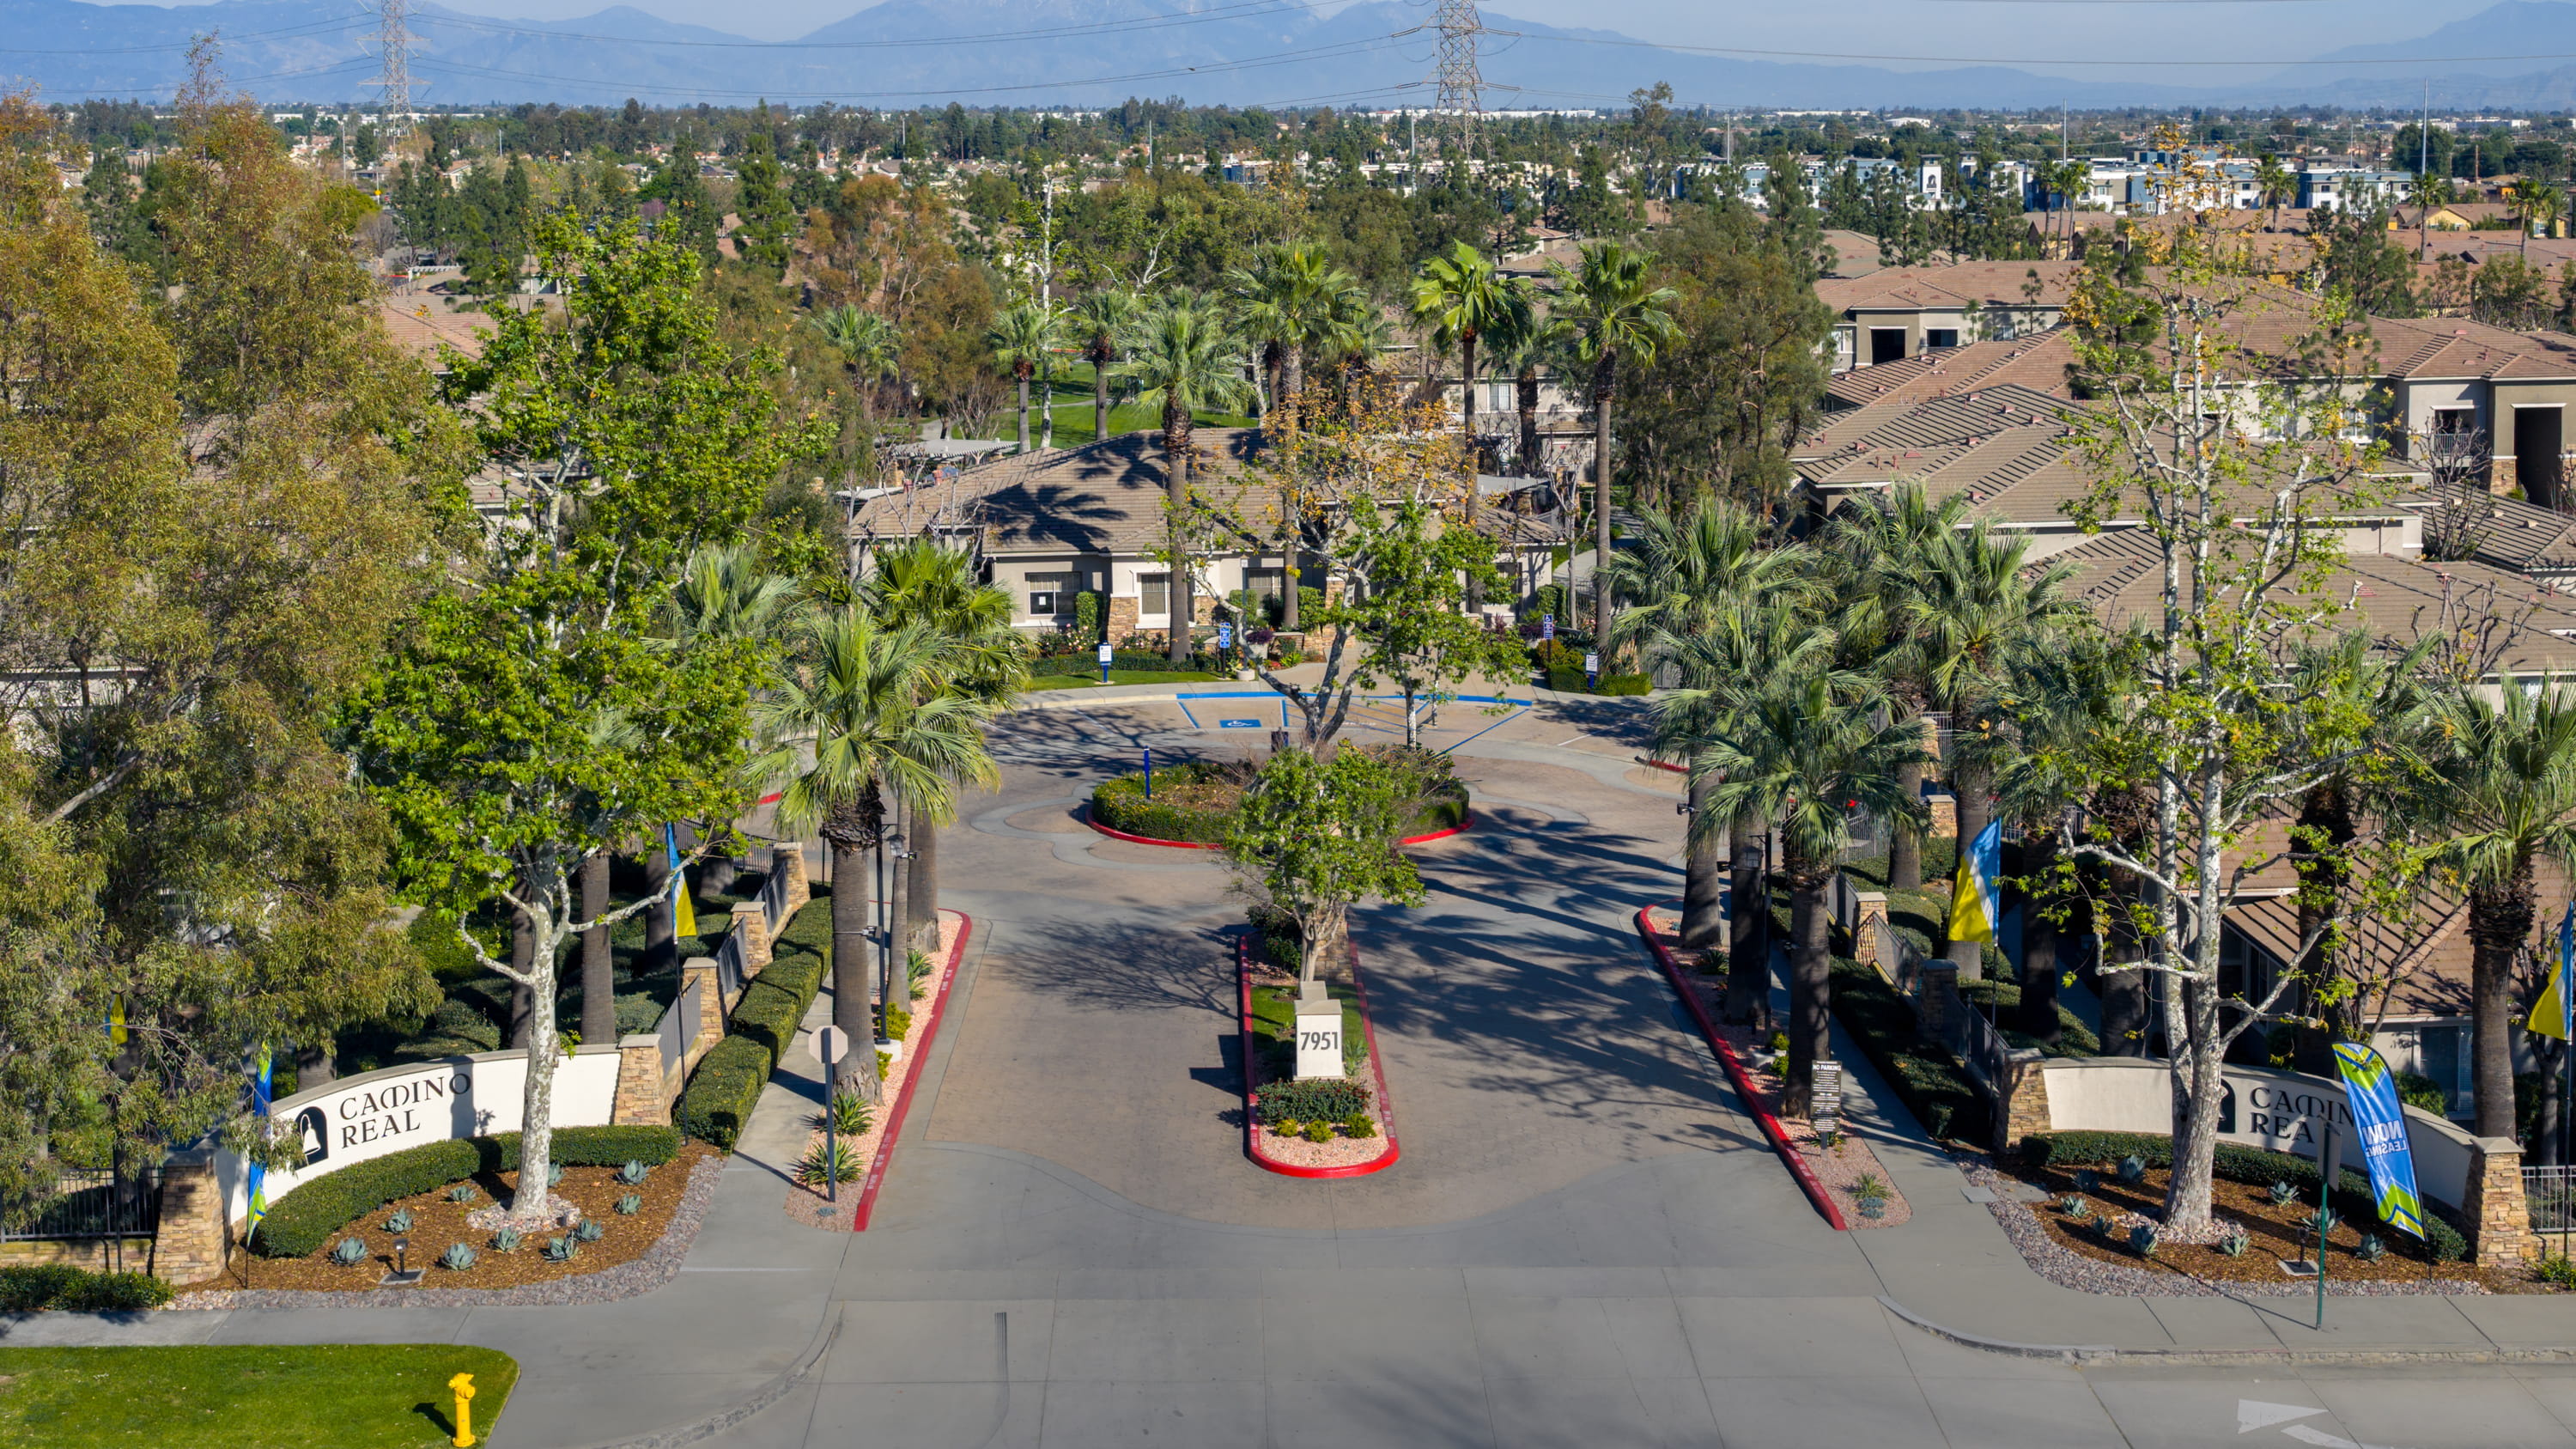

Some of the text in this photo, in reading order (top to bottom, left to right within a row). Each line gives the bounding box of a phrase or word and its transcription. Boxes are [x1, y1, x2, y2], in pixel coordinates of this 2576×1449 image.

[1300, 1032, 1338, 1050] 7951
[340, 1073, 471, 1120] CAMINO
[2251, 1087, 2354, 1127] CAMIN
[341, 1109, 421, 1149] REAL
[2250, 1111, 2316, 1144] REA
